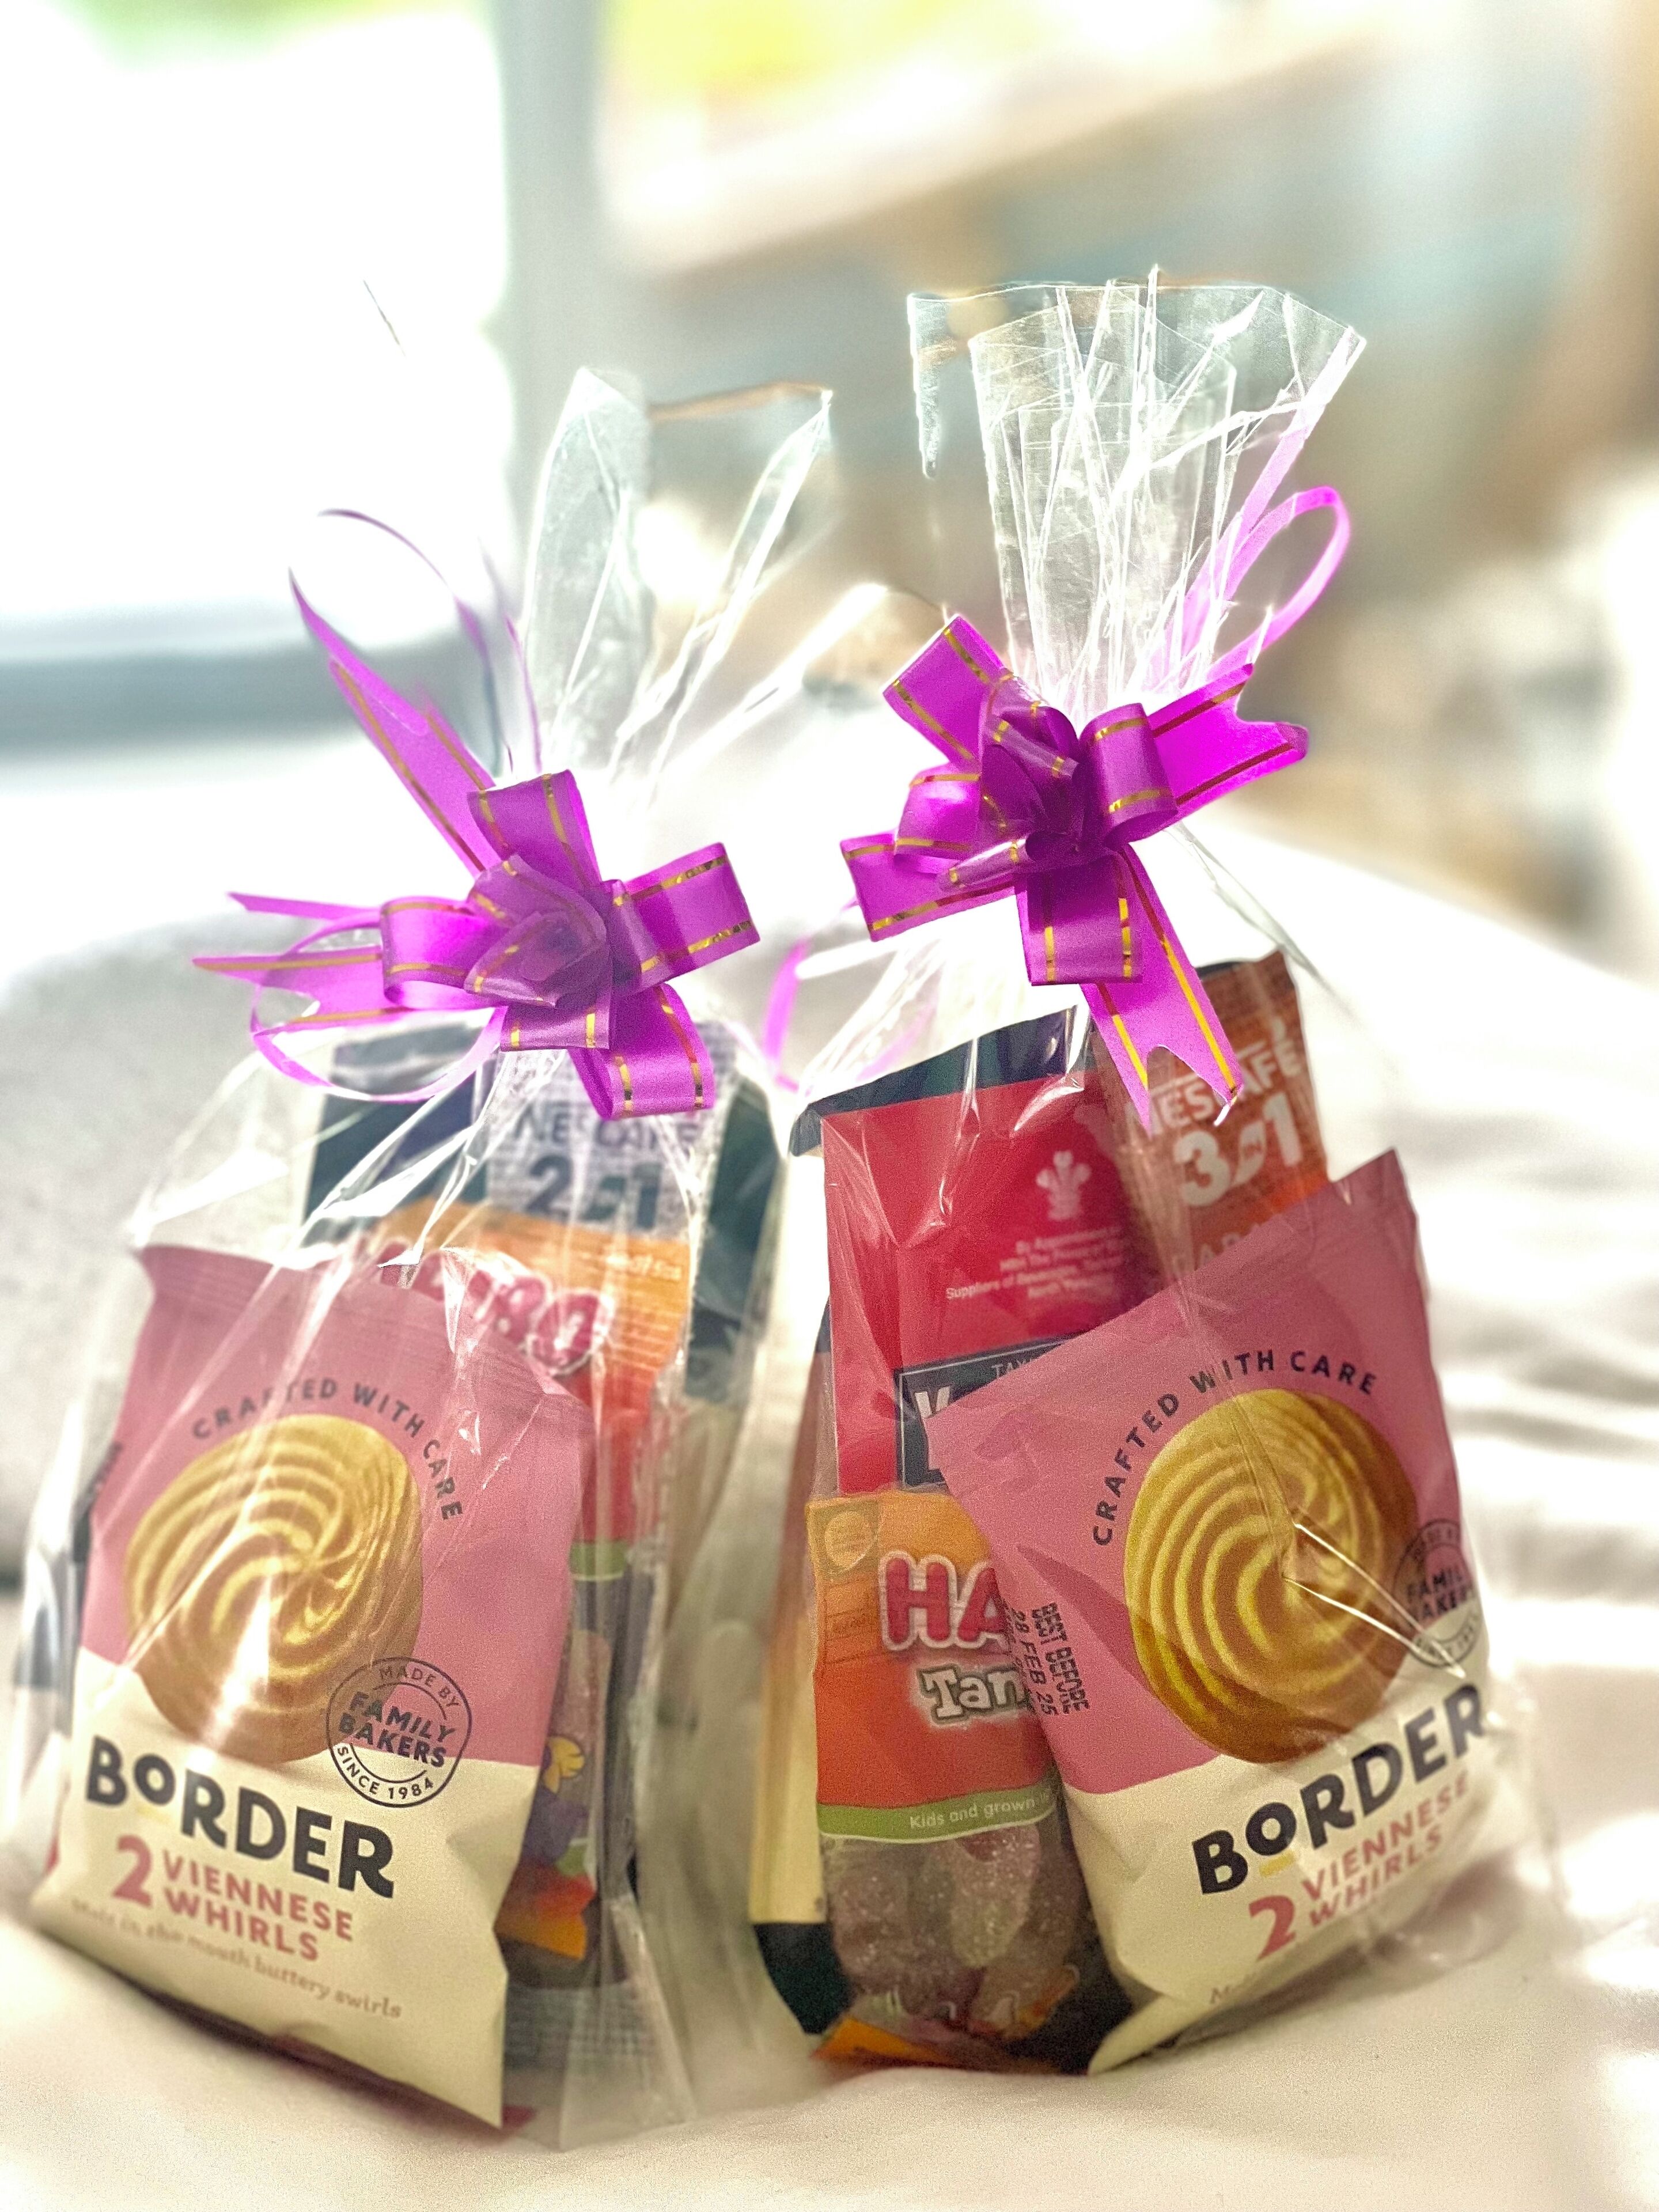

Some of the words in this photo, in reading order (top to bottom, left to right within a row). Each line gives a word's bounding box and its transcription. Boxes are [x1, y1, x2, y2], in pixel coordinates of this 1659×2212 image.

[192, 1377, 338, 1440] CRAFTED
[353, 1382, 425, 1438] WITH
[422, 1439, 463, 1521] CARE
[1093, 1392, 1179, 1547] CRAFTED
[1189, 1349, 1275, 1394] WITH
[1290, 1350, 1377, 1395] CARE
[379, 1665, 436, 1687] MADE
[438, 1685, 459, 1707] BY
[1020, 1641, 1047, 1684] FEB
[1036, 1691, 1059, 1715] 25
[339, 1712, 447, 1767] BAKERS
[349, 1691, 456, 1743] FAMILY
[337, 1746, 381, 1795] SINCE
[388, 1778, 433, 1800] 1984
[910, 1812, 945, 1828] Kids
[950, 1802, 978, 1823] and
[1301, 1771, 1469, 1901] VIENNESE
[112, 1835, 154, 1908] 2
[162, 1849, 354, 1943] VIENNESE
[1309, 1830, 1442, 1926] WHIRLS
[164, 1887, 319, 1962] WHIRLS
[1248, 1895, 1296, 1961] 2
[253, 1954, 333, 2002] buttery
[335, 1987, 402, 2019] swirls
